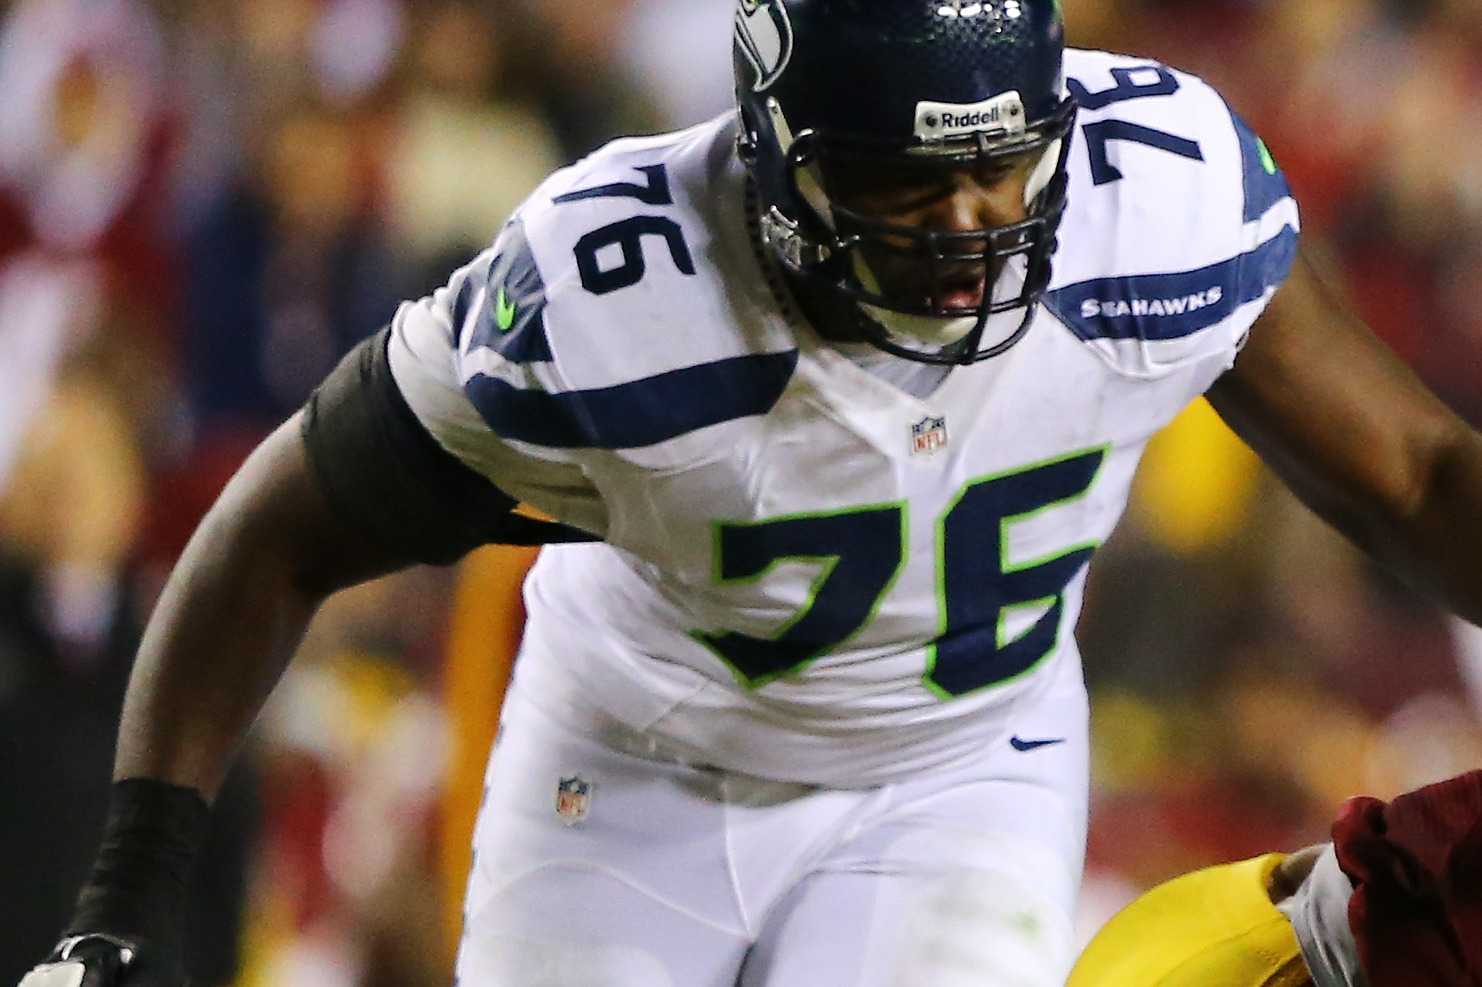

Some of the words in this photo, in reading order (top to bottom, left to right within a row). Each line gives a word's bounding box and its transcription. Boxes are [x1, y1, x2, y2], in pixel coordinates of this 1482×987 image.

[941, 103, 999, 128] Riddell
[551, 163, 697, 296] 76
[1080, 286, 1223, 319] SEAHAWKS
[687, 442, 1113, 700] 76
